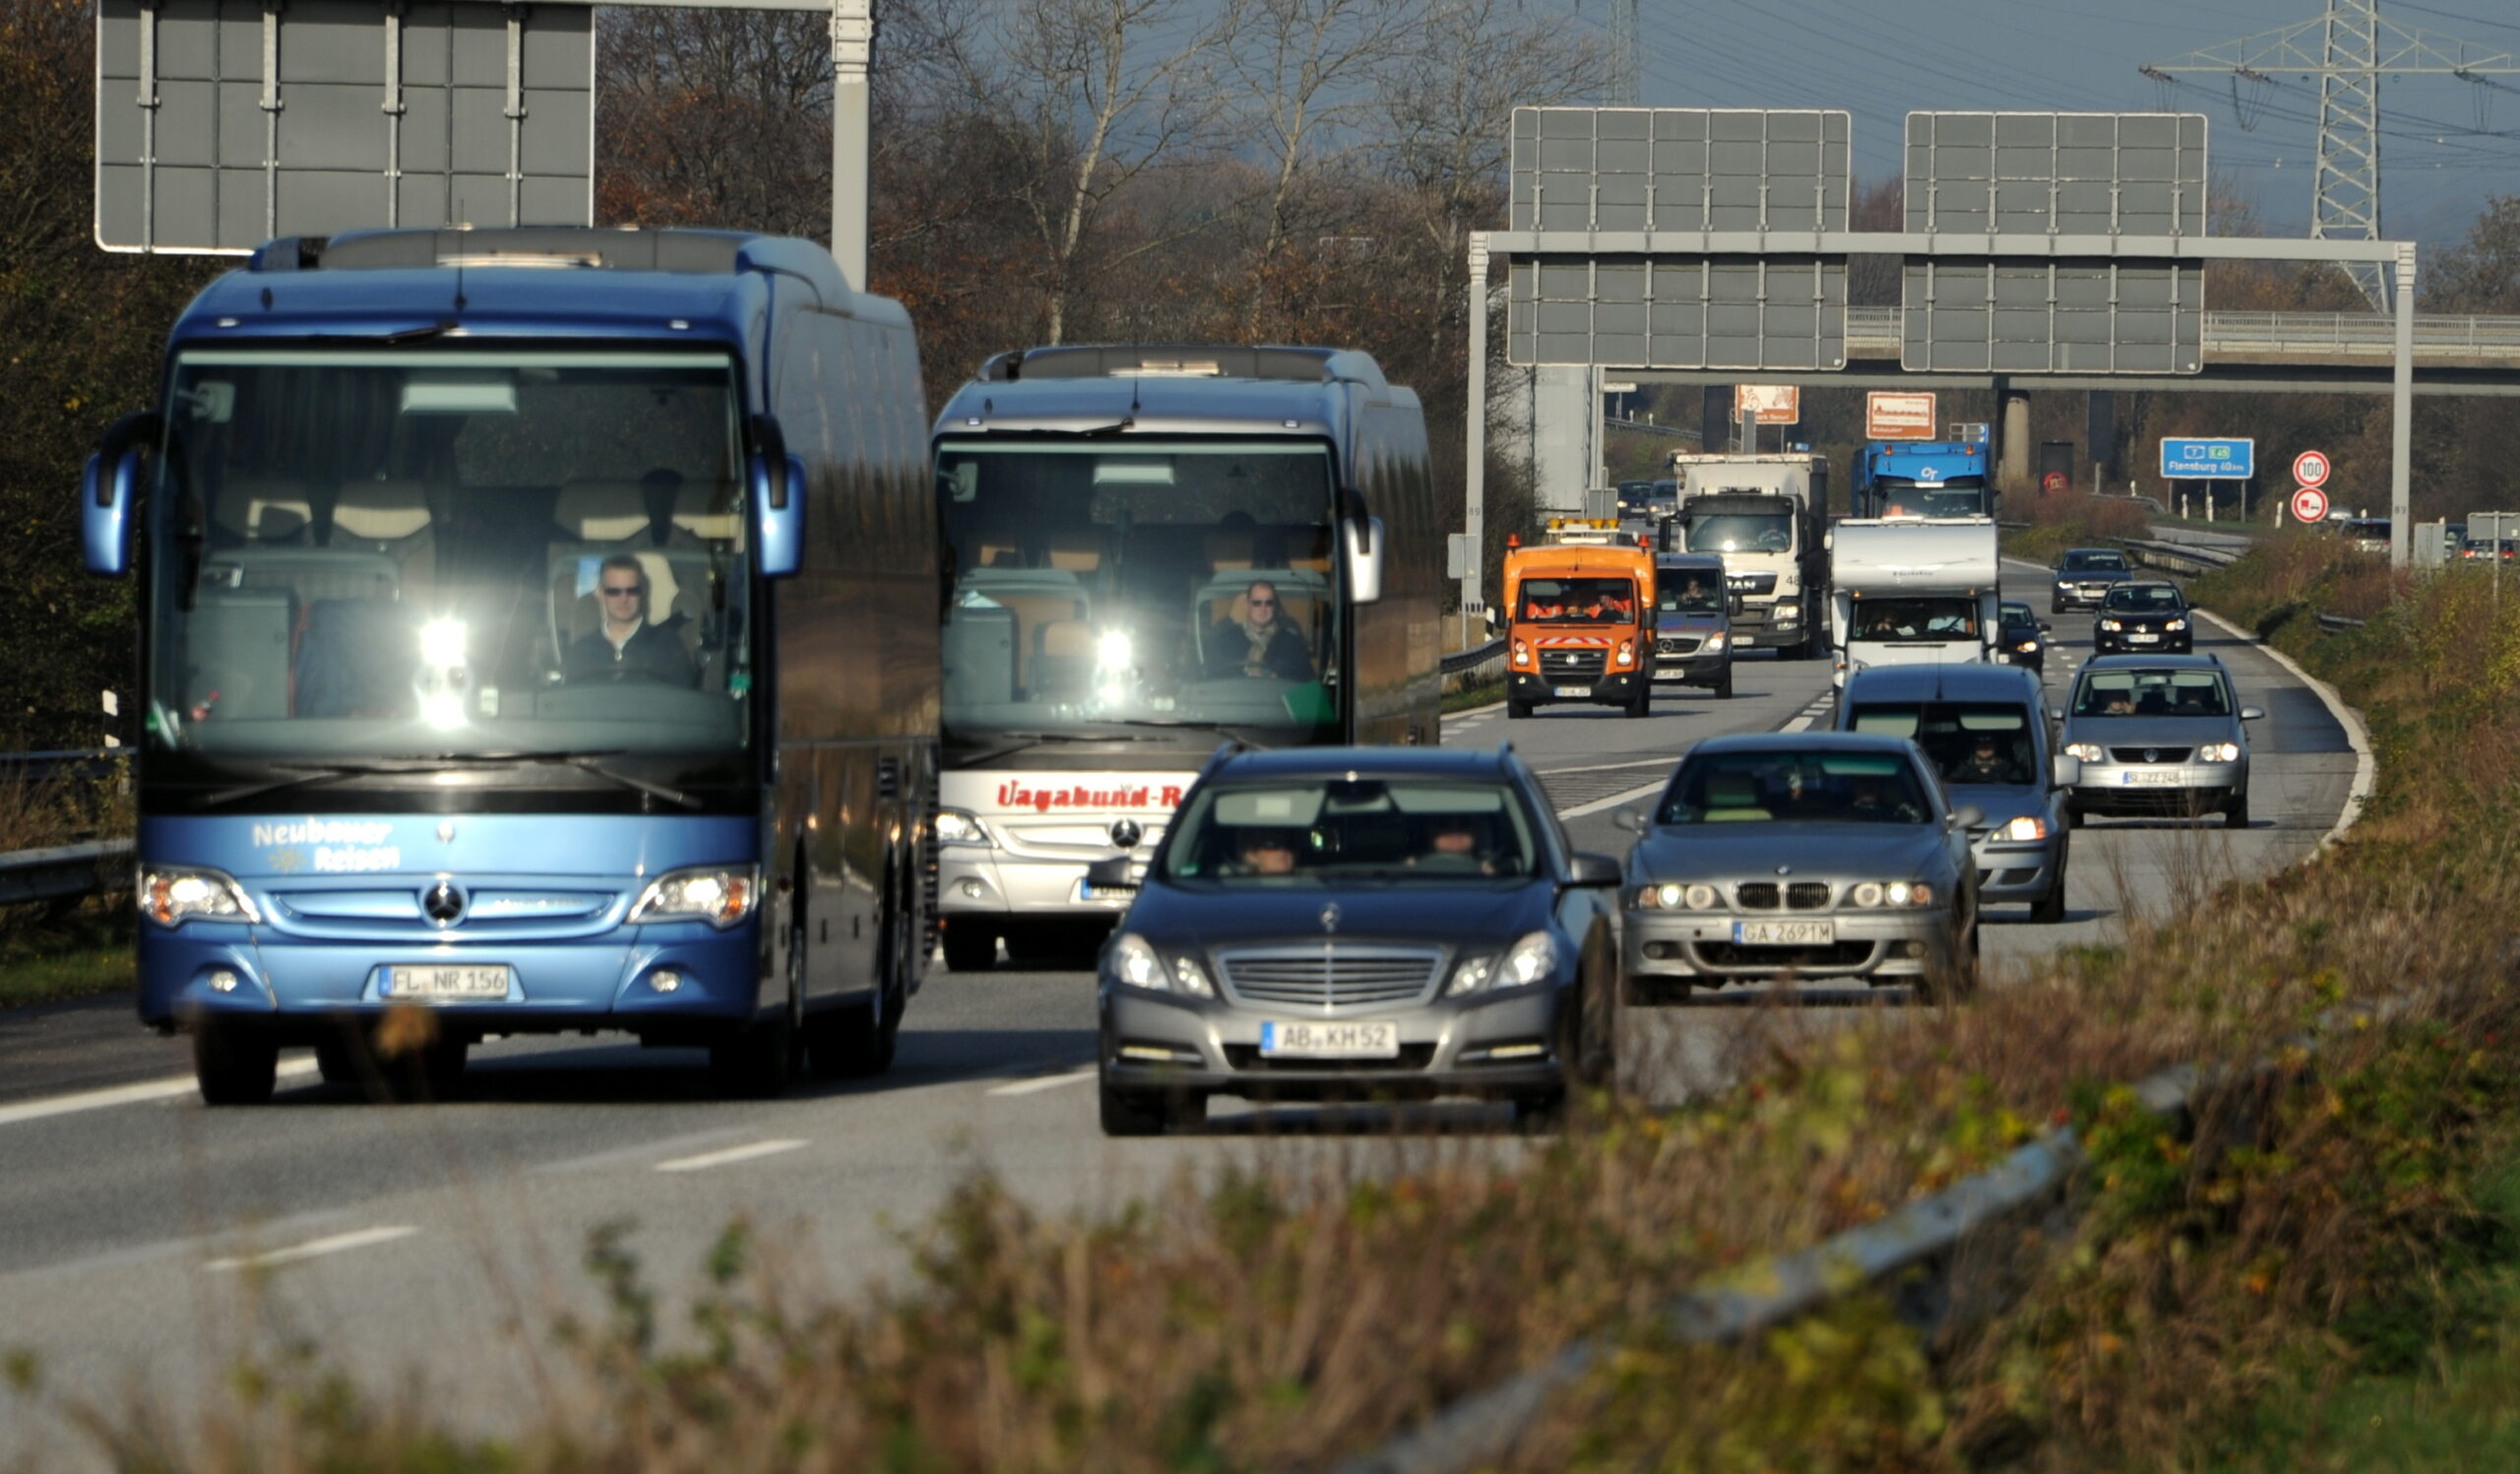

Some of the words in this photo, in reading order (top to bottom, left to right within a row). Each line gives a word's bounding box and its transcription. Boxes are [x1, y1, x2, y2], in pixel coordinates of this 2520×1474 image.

[2169, 461, 2218, 473] Flensburg
[2301, 462, 2322, 477] 100
[254, 816, 393, 847] Neubauer
[314, 845, 402, 871] Reisen
[467, 970, 505, 991] 156
